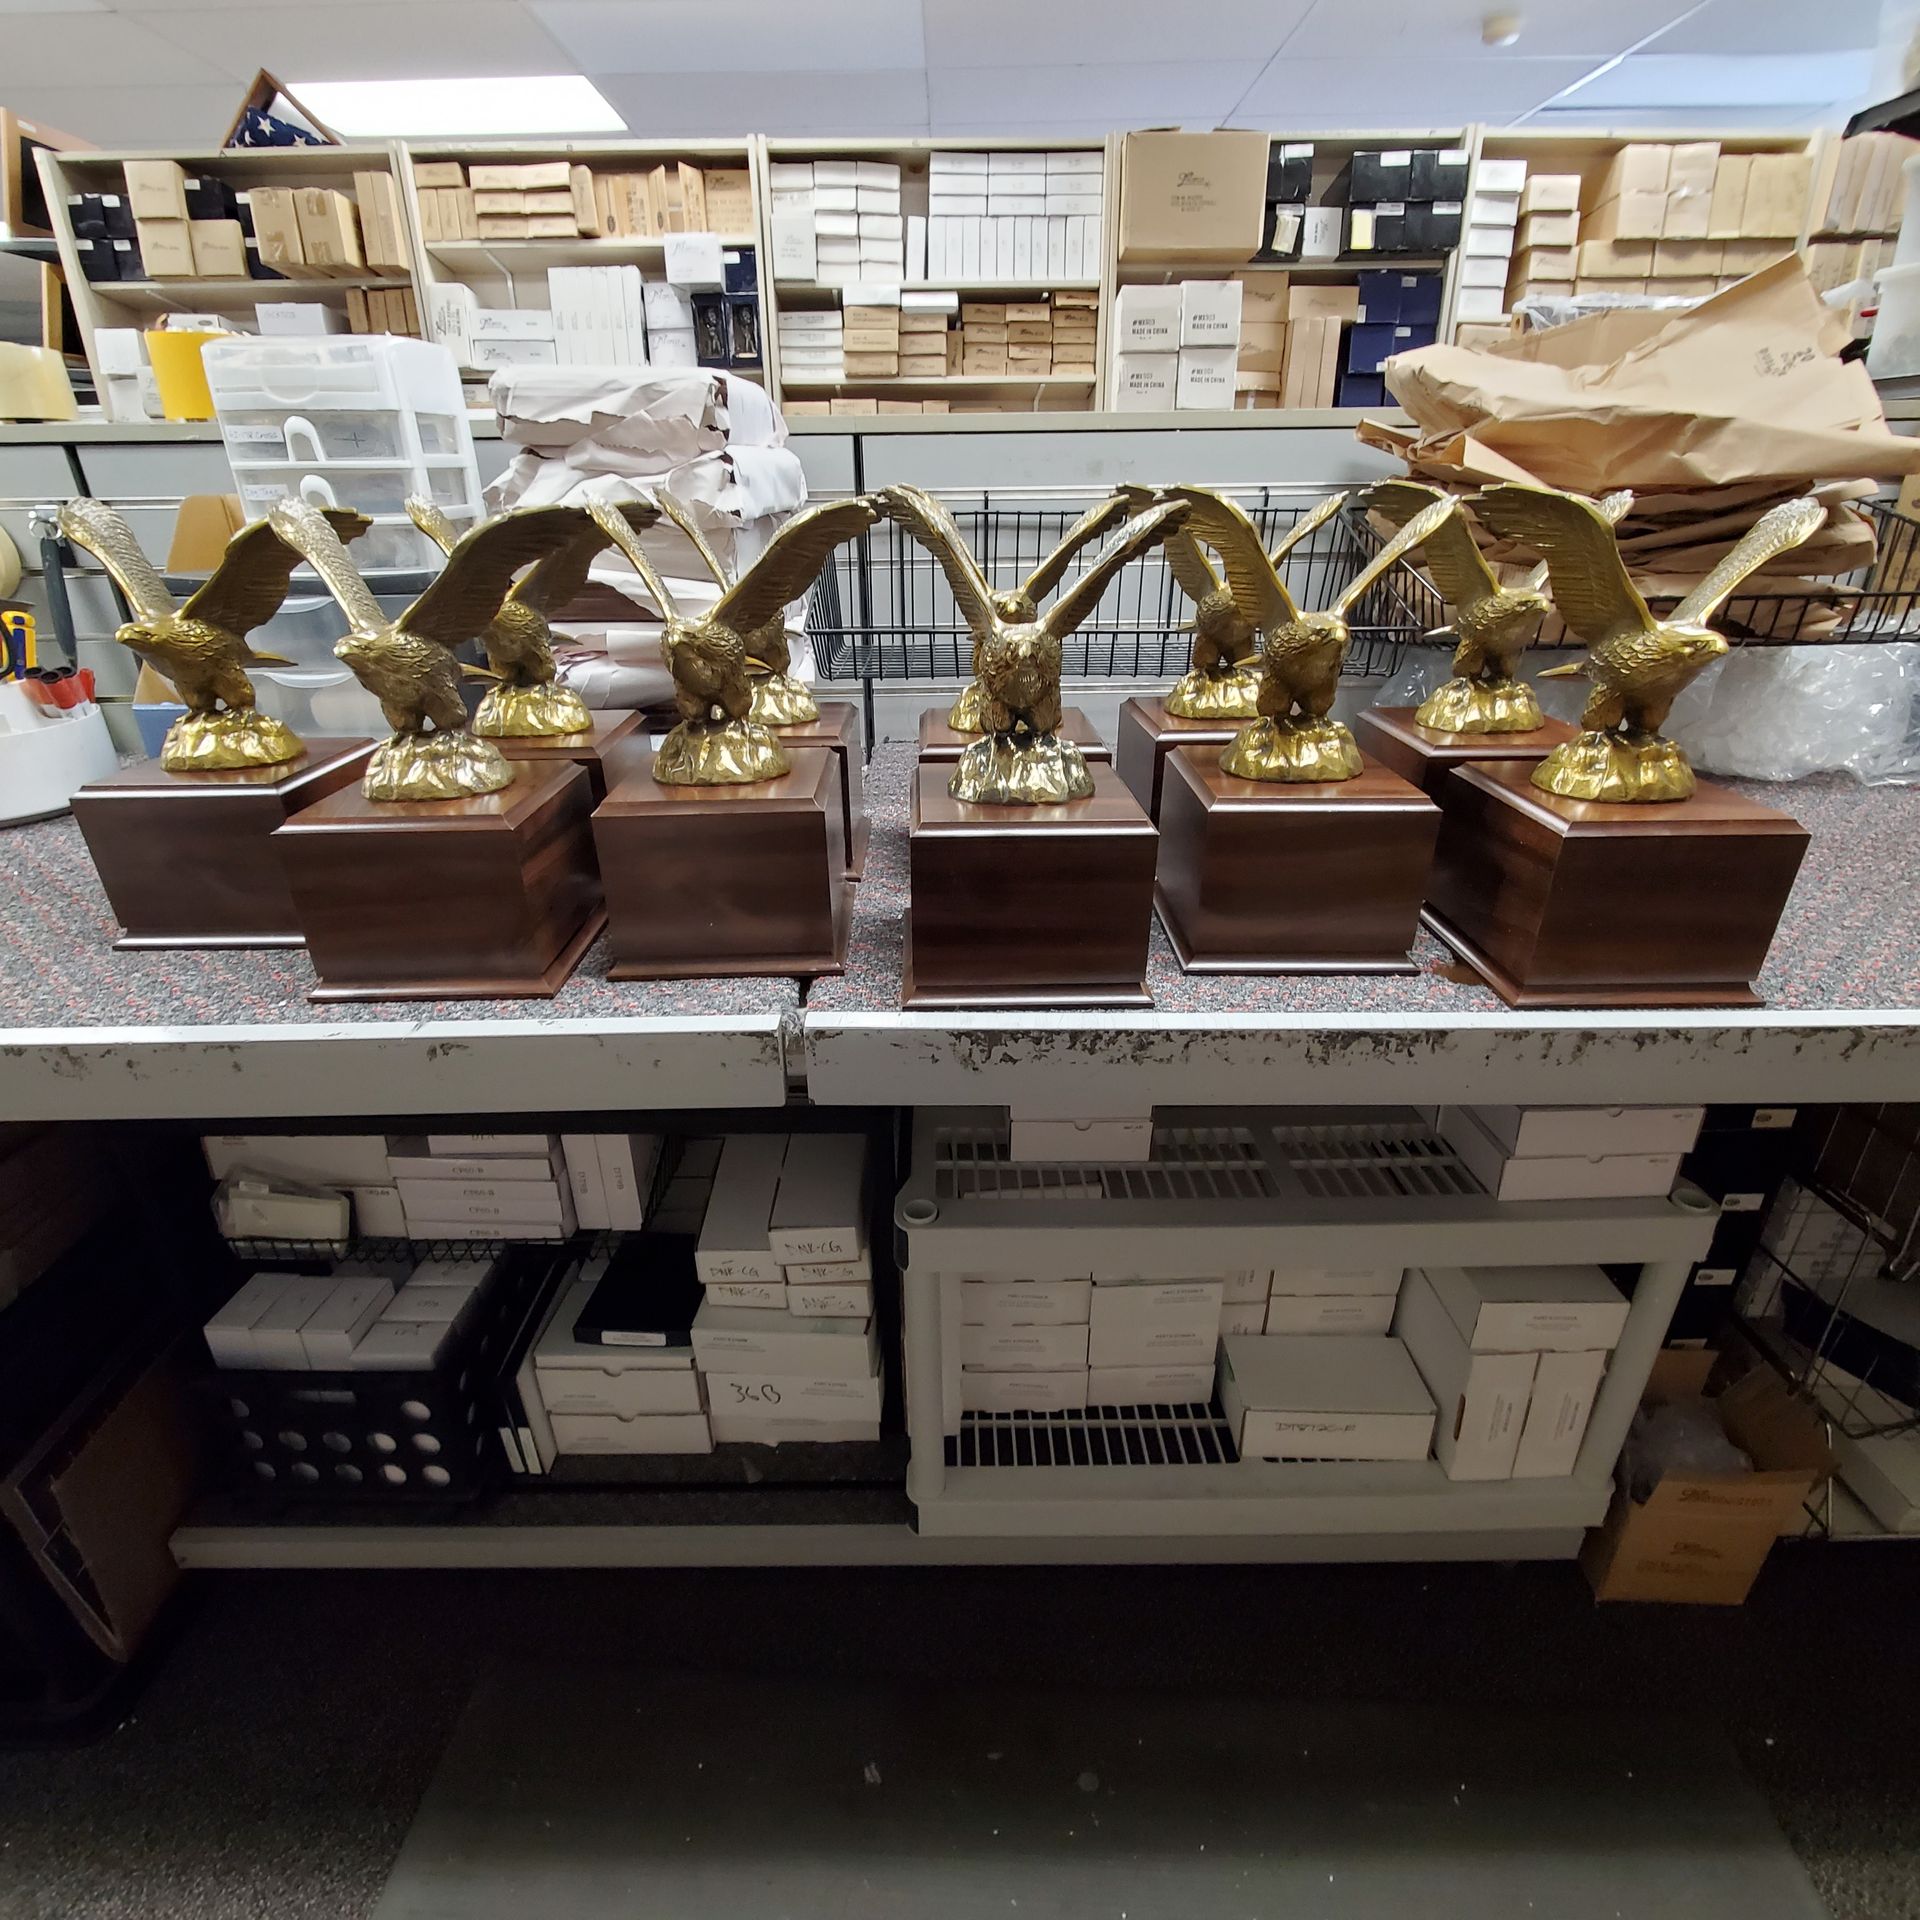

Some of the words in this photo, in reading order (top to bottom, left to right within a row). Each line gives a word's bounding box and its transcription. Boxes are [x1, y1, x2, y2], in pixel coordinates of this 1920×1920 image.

[1213, 322, 1228, 330] CHINA
[1132, 327, 1146, 335] MADE
[1146, 327, 1152, 335] IN
[1153, 327, 1168, 335] CHINA
